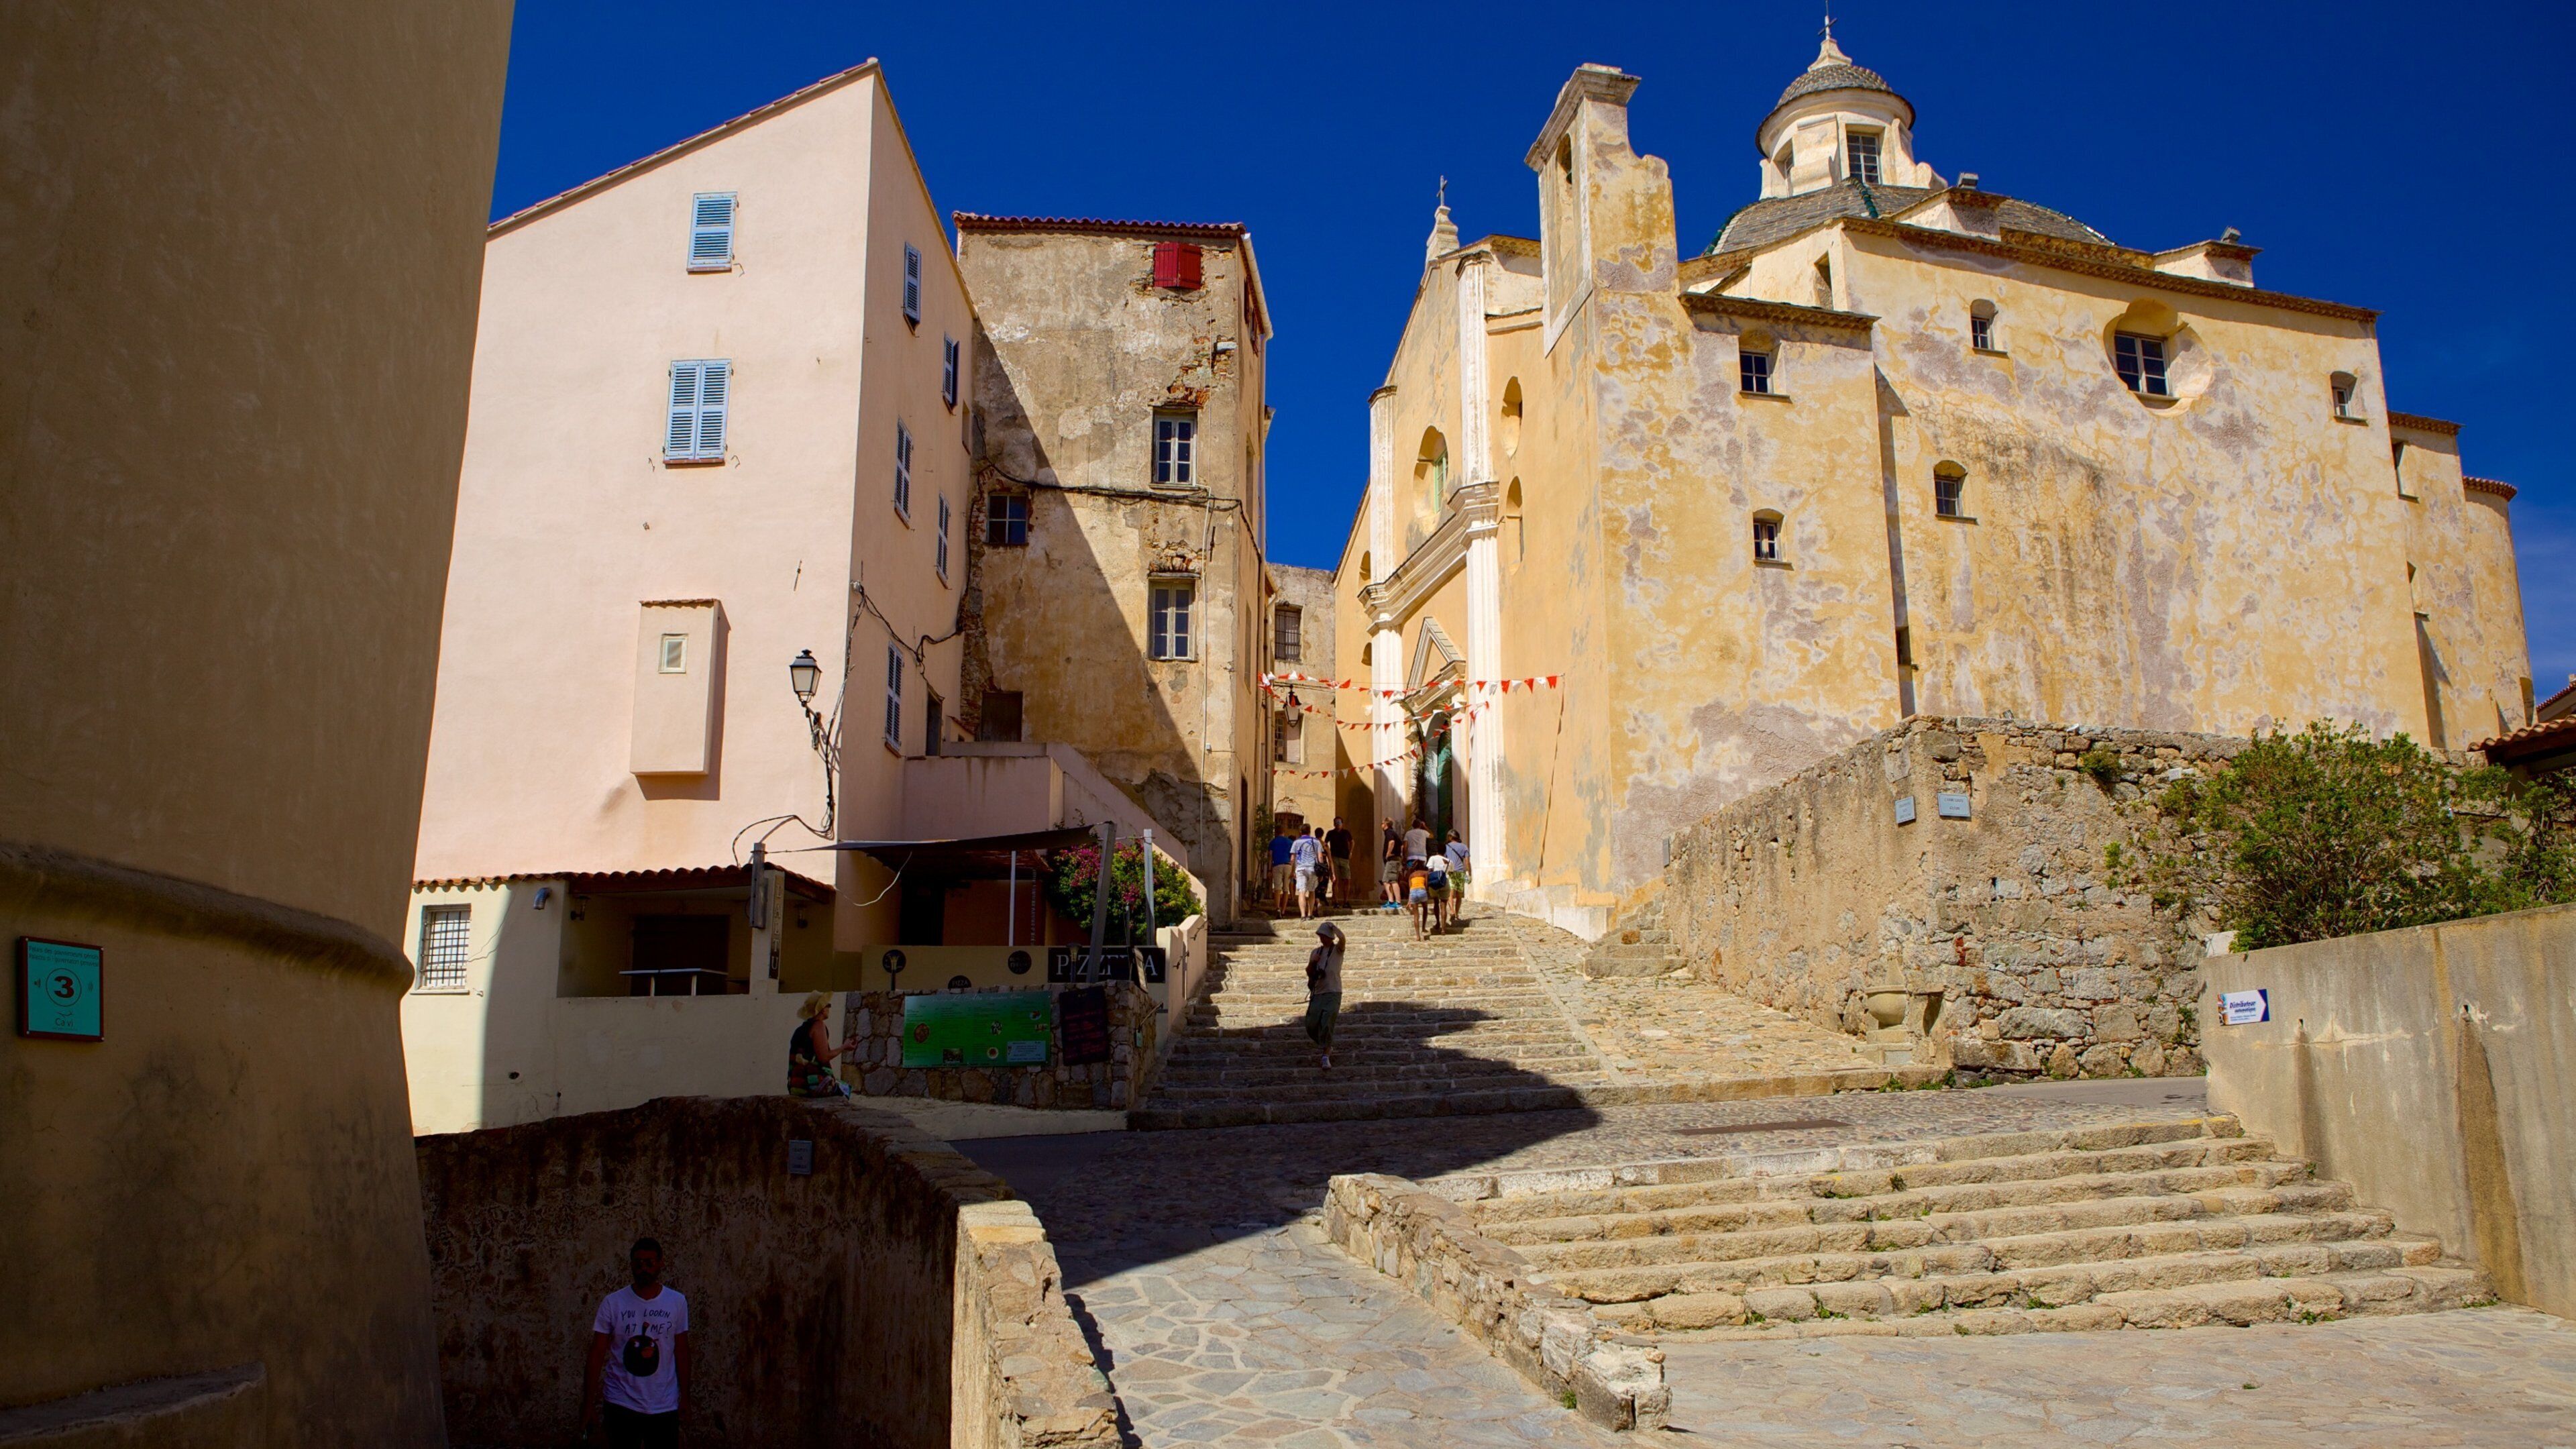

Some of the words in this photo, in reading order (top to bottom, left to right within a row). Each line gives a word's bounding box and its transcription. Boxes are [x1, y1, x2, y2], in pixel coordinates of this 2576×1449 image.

[1056, 955, 1158, 975] PZZA
[54, 975, 74, 998] 3
[621, 1309, 636, 1321] YOU
[625, 1323, 637, 1334] AT
